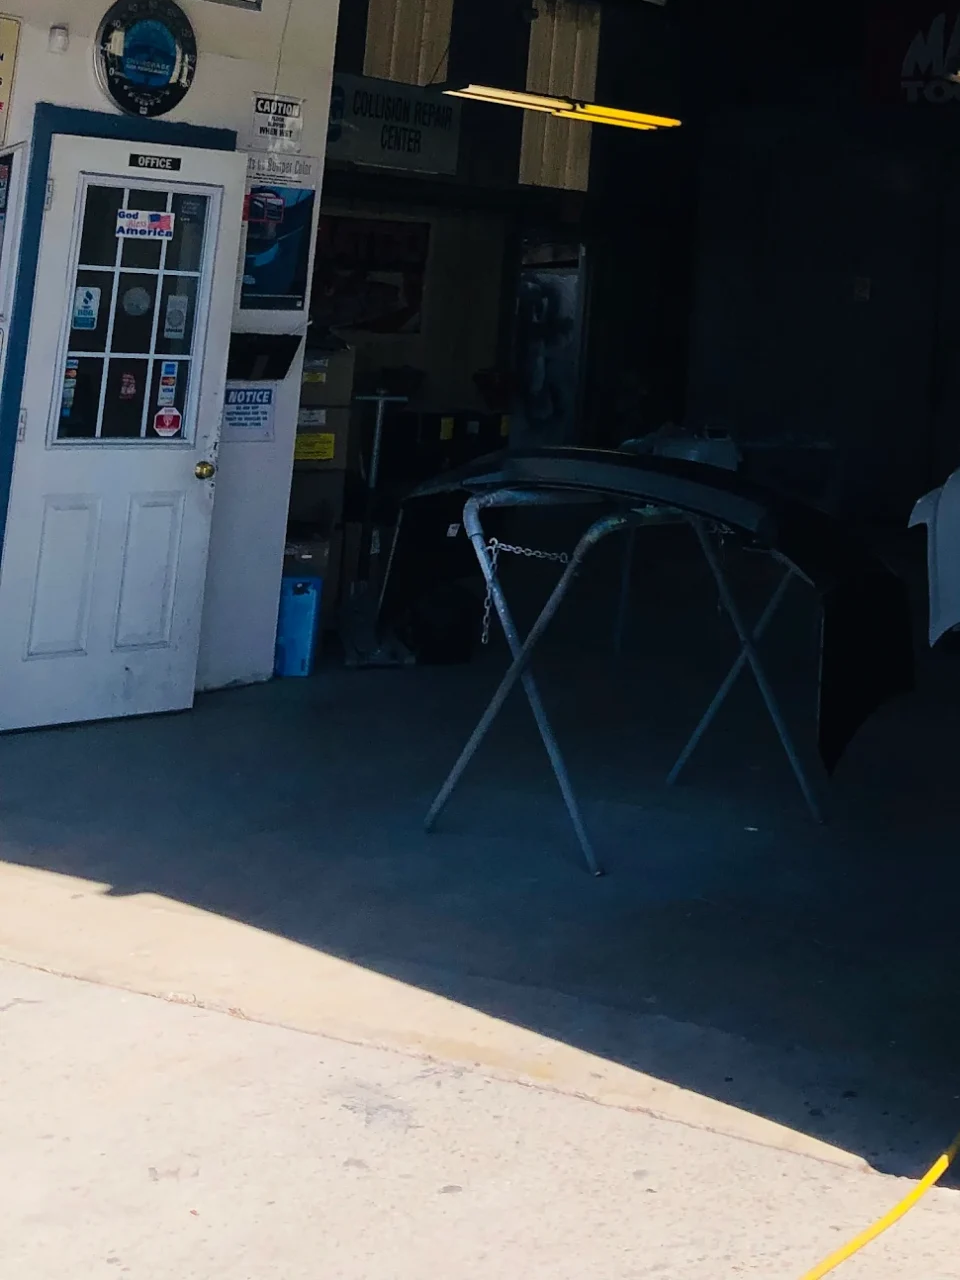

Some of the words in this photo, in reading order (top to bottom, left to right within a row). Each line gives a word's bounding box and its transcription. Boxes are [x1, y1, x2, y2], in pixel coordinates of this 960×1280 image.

[257, 99, 300, 117] CAUTION
[353, 89, 411, 124] COLLISION
[414, 101, 453, 131] REPAIR
[259, 126, 278, 136] WHEN
[381, 124, 422, 154] CENTER
[138, 156, 172, 169] OFFICE
[118, 211, 139, 220] God
[116, 226, 173, 237] America
[228, 391, 270, 404] NOTICE
